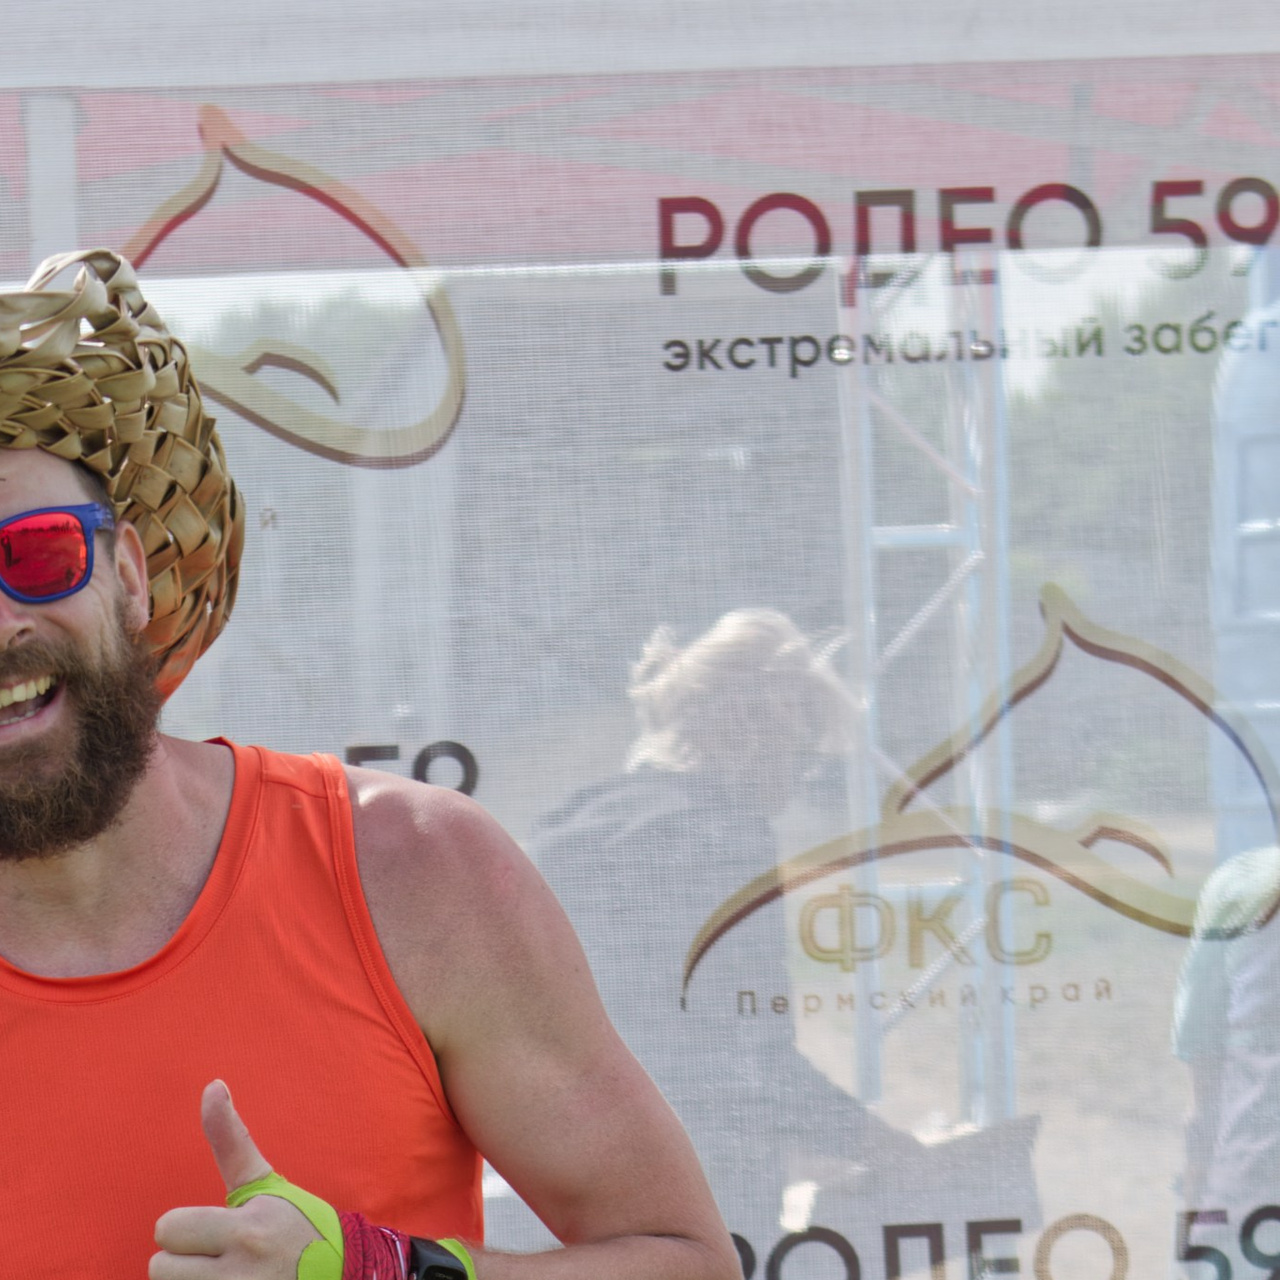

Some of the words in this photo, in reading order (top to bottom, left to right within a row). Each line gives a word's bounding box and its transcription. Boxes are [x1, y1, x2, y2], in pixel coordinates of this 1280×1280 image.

[658, 183, 1103, 308] РОДЕО
[1150, 176, 1280, 281] 59
[798, 877, 1055, 973] ФКС
[735, 982, 978, 1018] Пермский
[1000, 977, 1114, 1010] край
